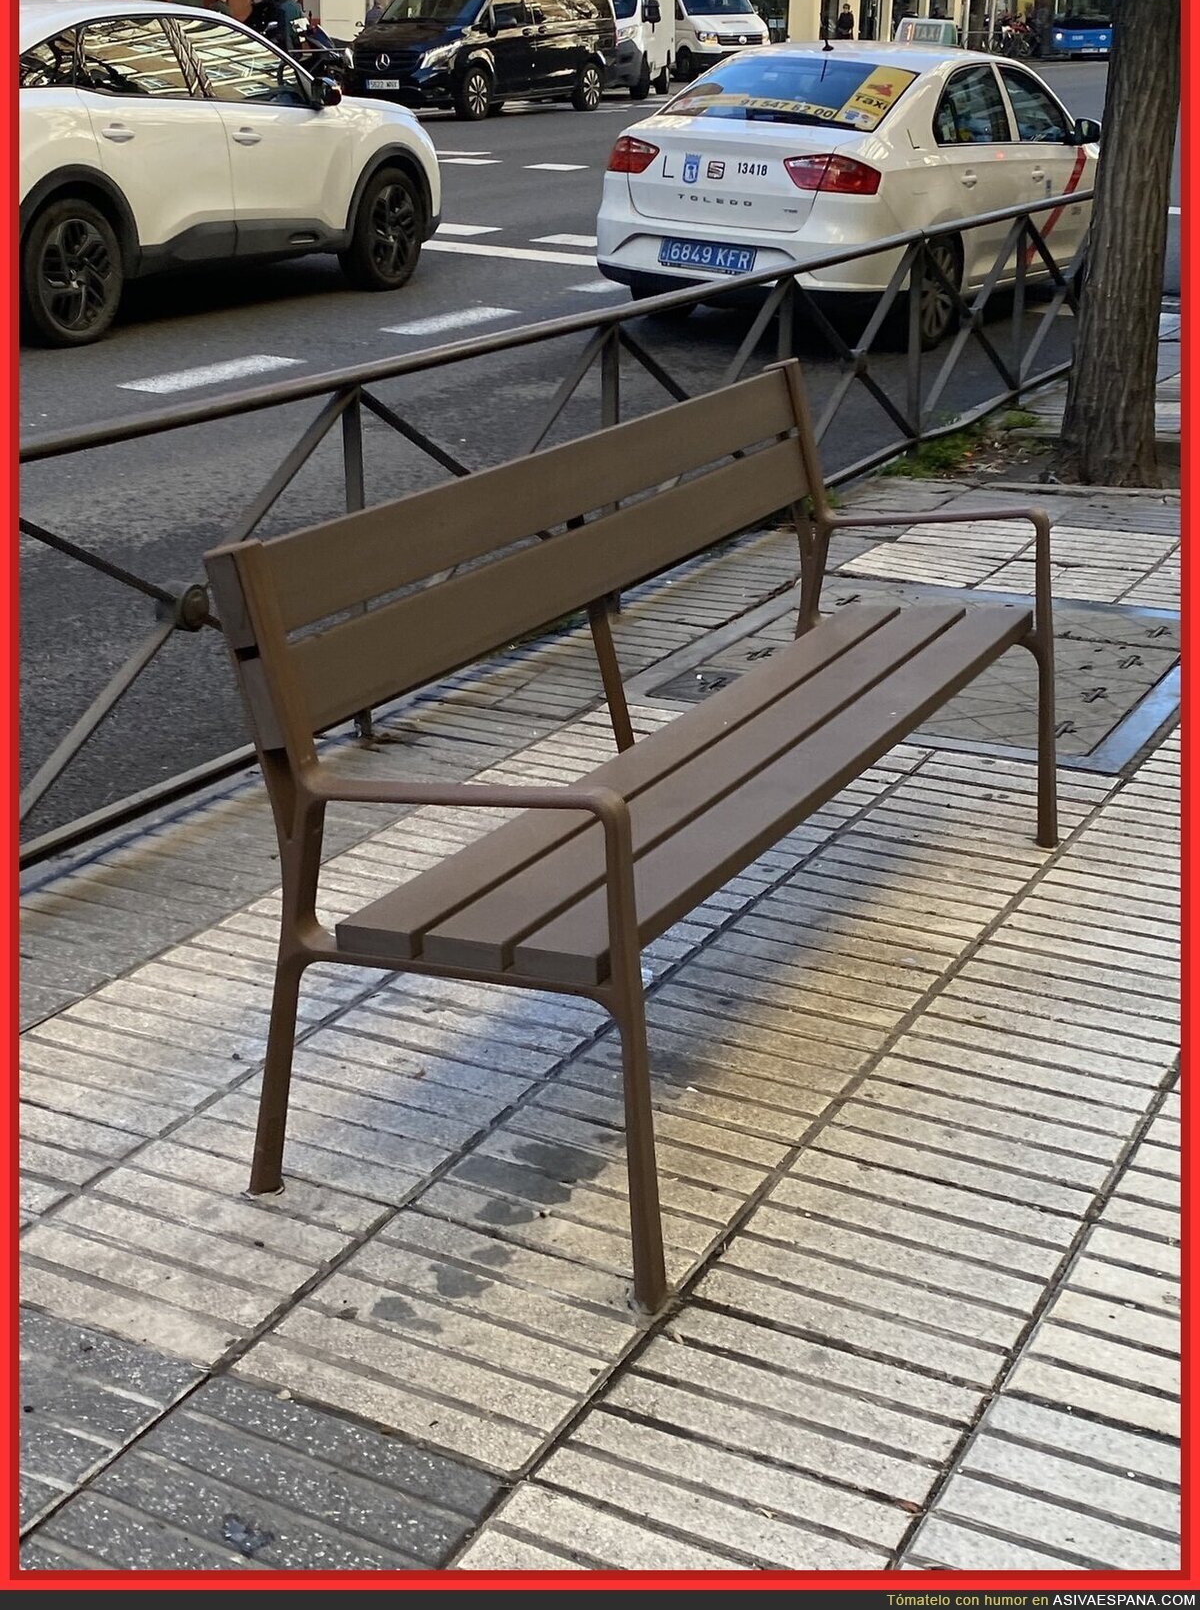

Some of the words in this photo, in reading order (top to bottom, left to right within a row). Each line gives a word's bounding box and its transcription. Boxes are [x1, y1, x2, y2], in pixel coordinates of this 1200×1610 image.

[760, 99, 790, 109] 547
[813, 108, 834, 118] 00
[662, 155, 674, 178] L
[737, 162, 768, 177] 13418
[677, 193, 753, 207] TOLEDO
[670, 242, 712, 264] 6849
[715, 247, 750, 270] KFR
